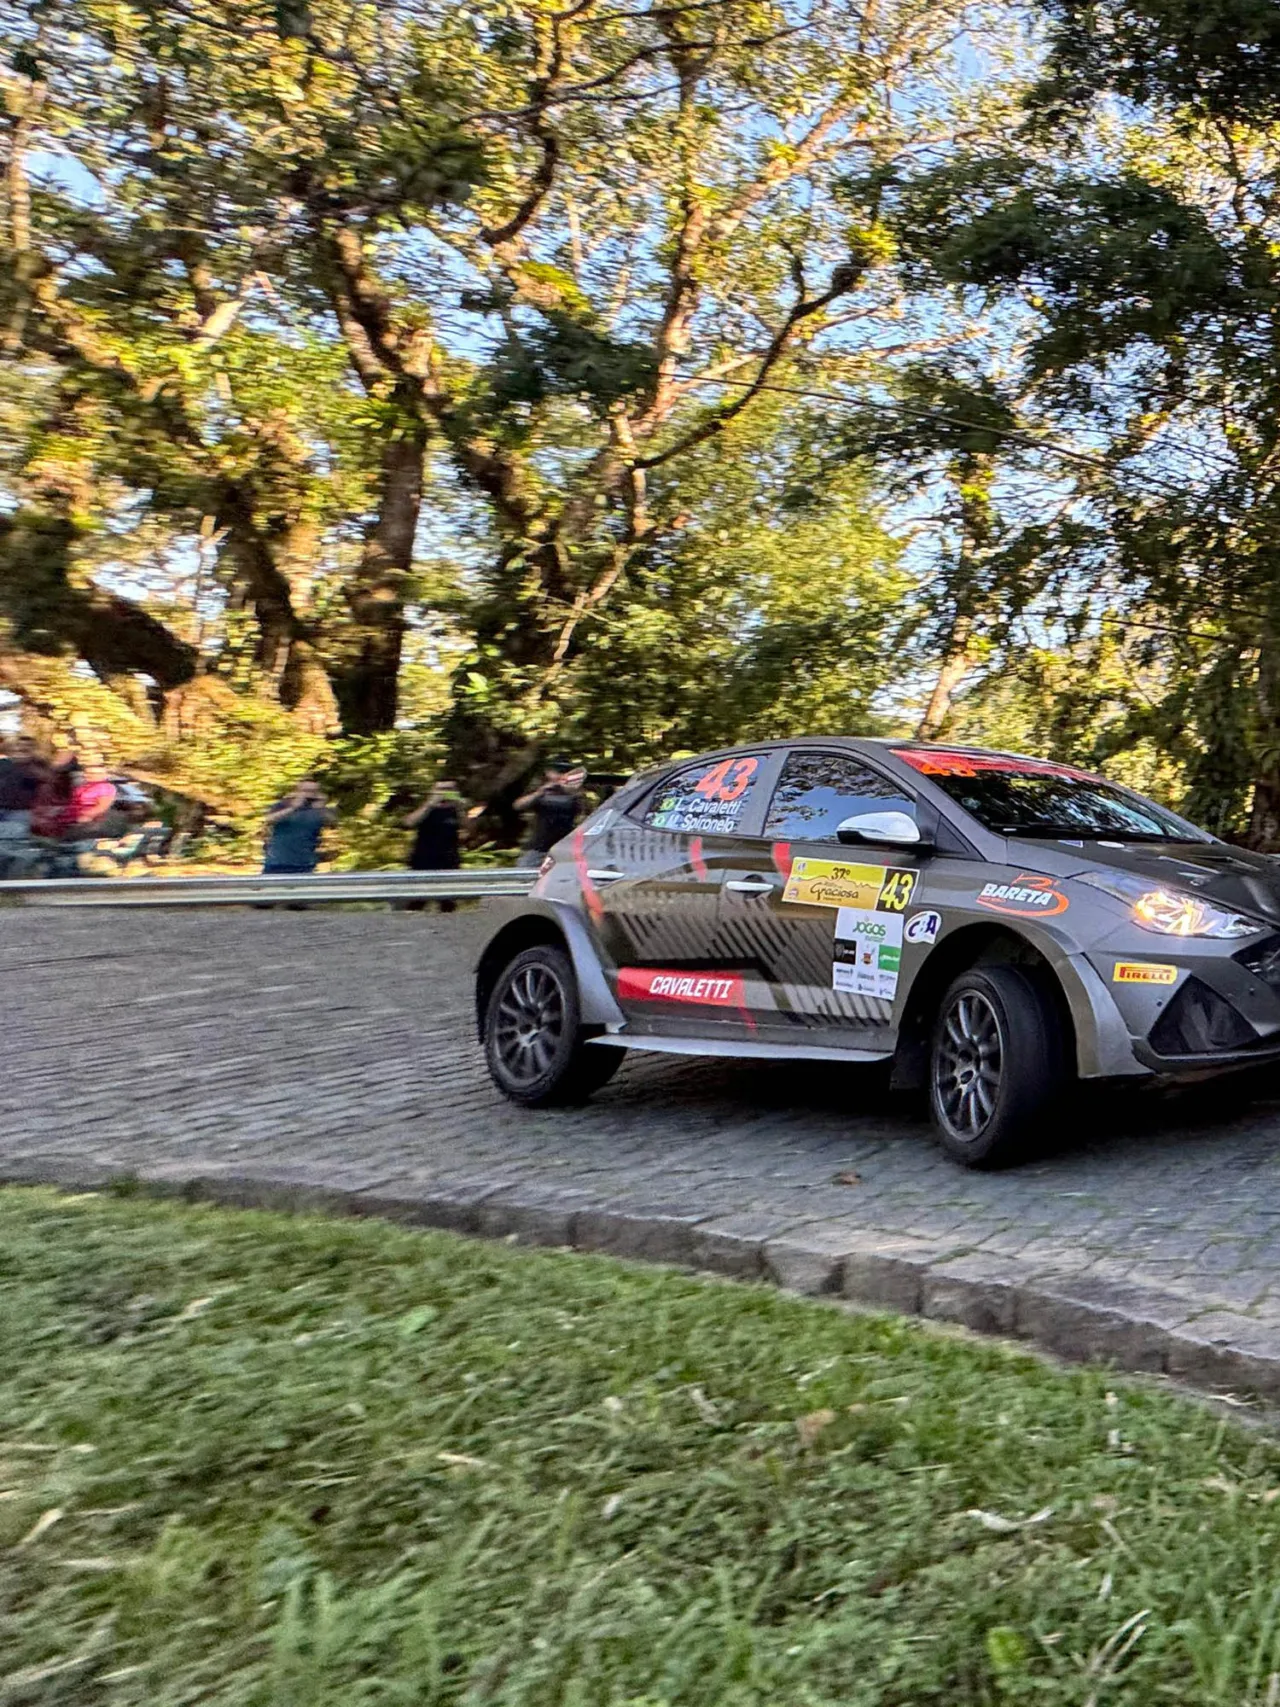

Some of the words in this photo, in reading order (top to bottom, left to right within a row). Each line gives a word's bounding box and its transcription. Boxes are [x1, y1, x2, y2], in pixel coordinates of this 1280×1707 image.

[694, 758, 758, 801] 43
[688, 799, 742, 815] Cavaletti
[810, 882, 859, 901] Graciosa
[880, 872, 914, 911] 43
[980, 883, 1053, 906] BARETA
[852, 921, 887, 937] JOGOS
[1119, 966, 1173, 981] PIRELLI
[649, 976, 734, 999] CAVALETTI
